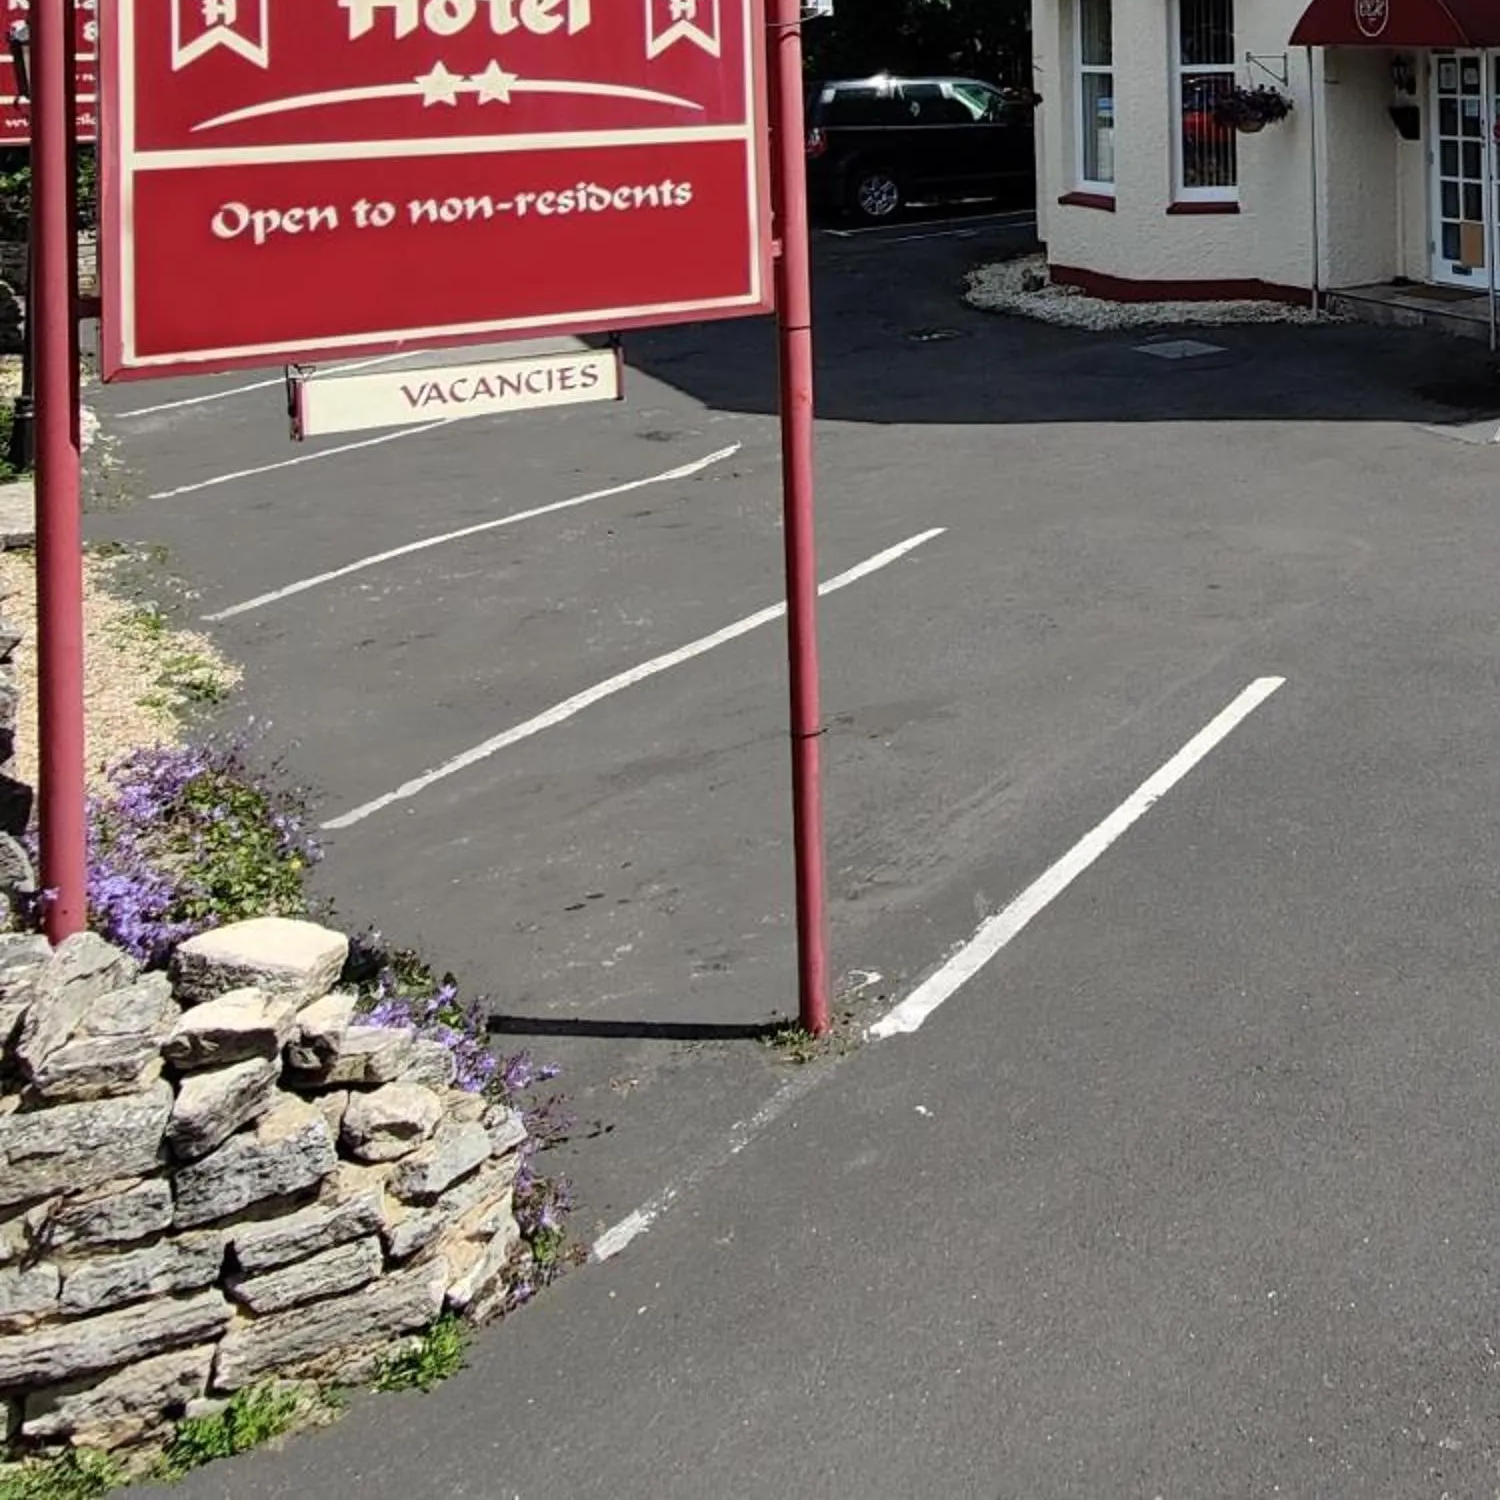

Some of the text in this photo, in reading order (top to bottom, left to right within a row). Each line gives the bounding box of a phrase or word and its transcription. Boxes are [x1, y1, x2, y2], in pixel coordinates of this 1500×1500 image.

[211, 179, 693, 245] Open to non-residents
[400, 363, 600, 408] VACANCIES
